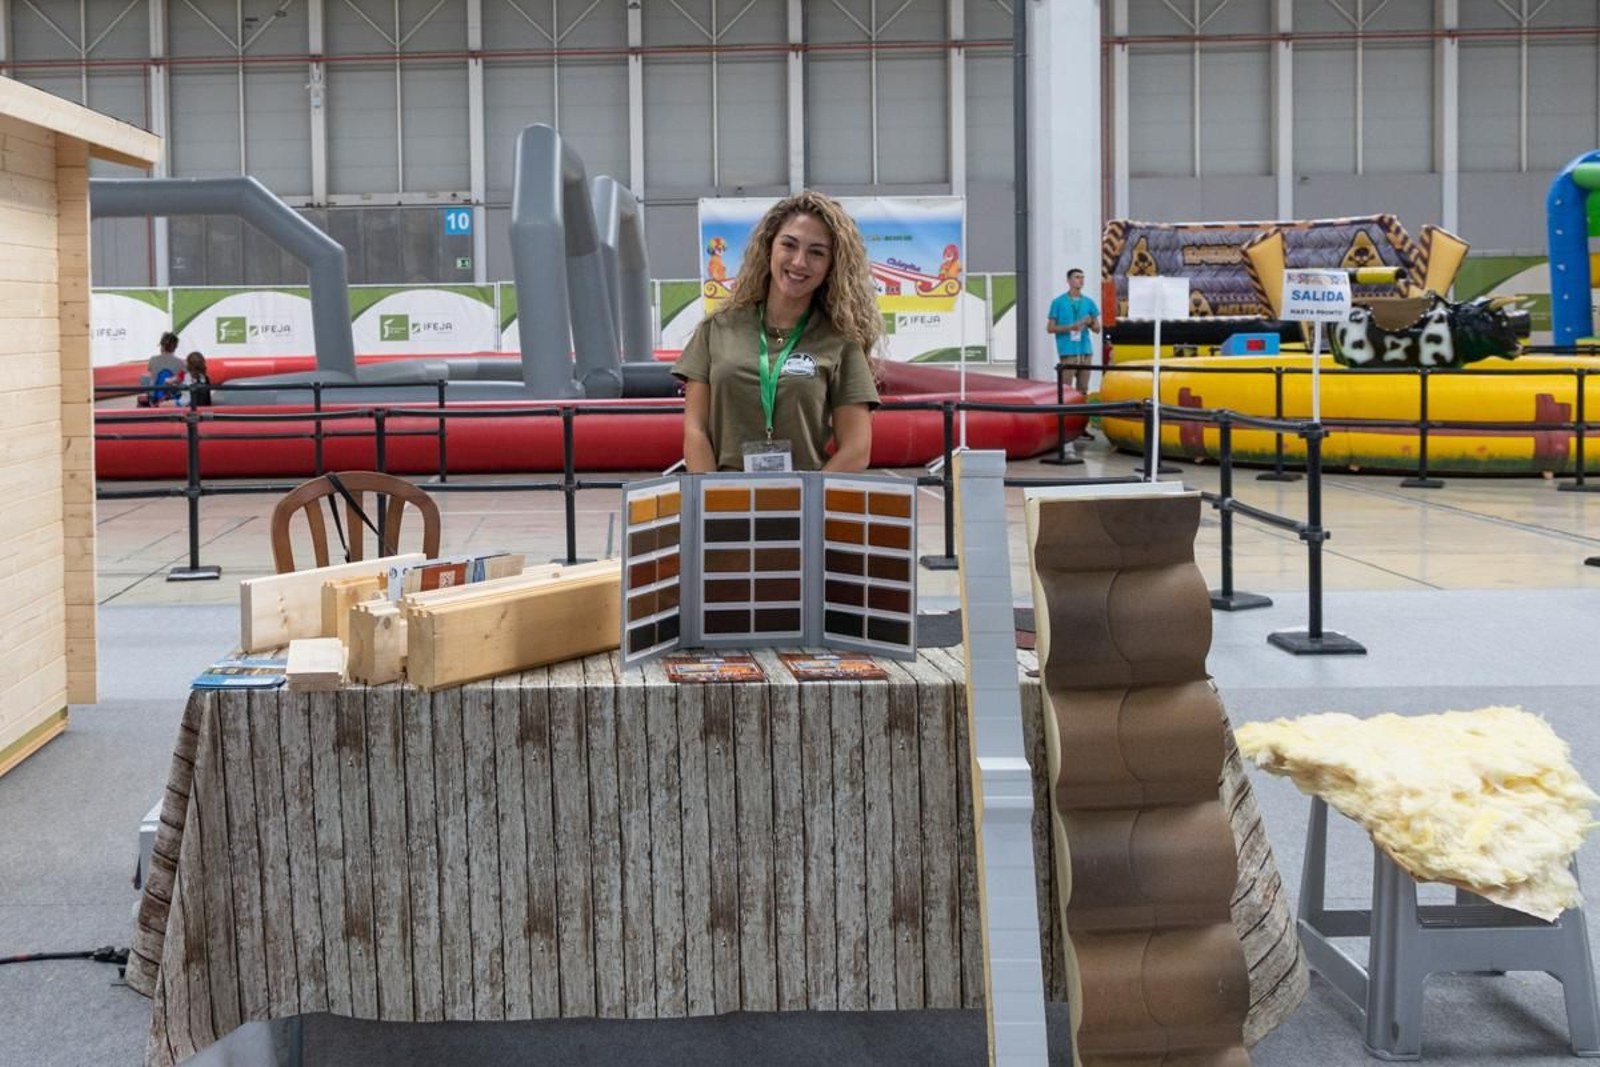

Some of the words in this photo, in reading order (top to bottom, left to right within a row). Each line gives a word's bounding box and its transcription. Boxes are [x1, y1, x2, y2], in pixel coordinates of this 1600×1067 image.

[447, 212, 470, 230] 10
[1291, 290, 1344, 302] SALIDA
[910, 315, 941, 324] IFEJA
[261, 325, 291, 333] IFEJA
[423, 322, 453, 331] IFEJA
[96, 328, 126, 337] IFEJA
